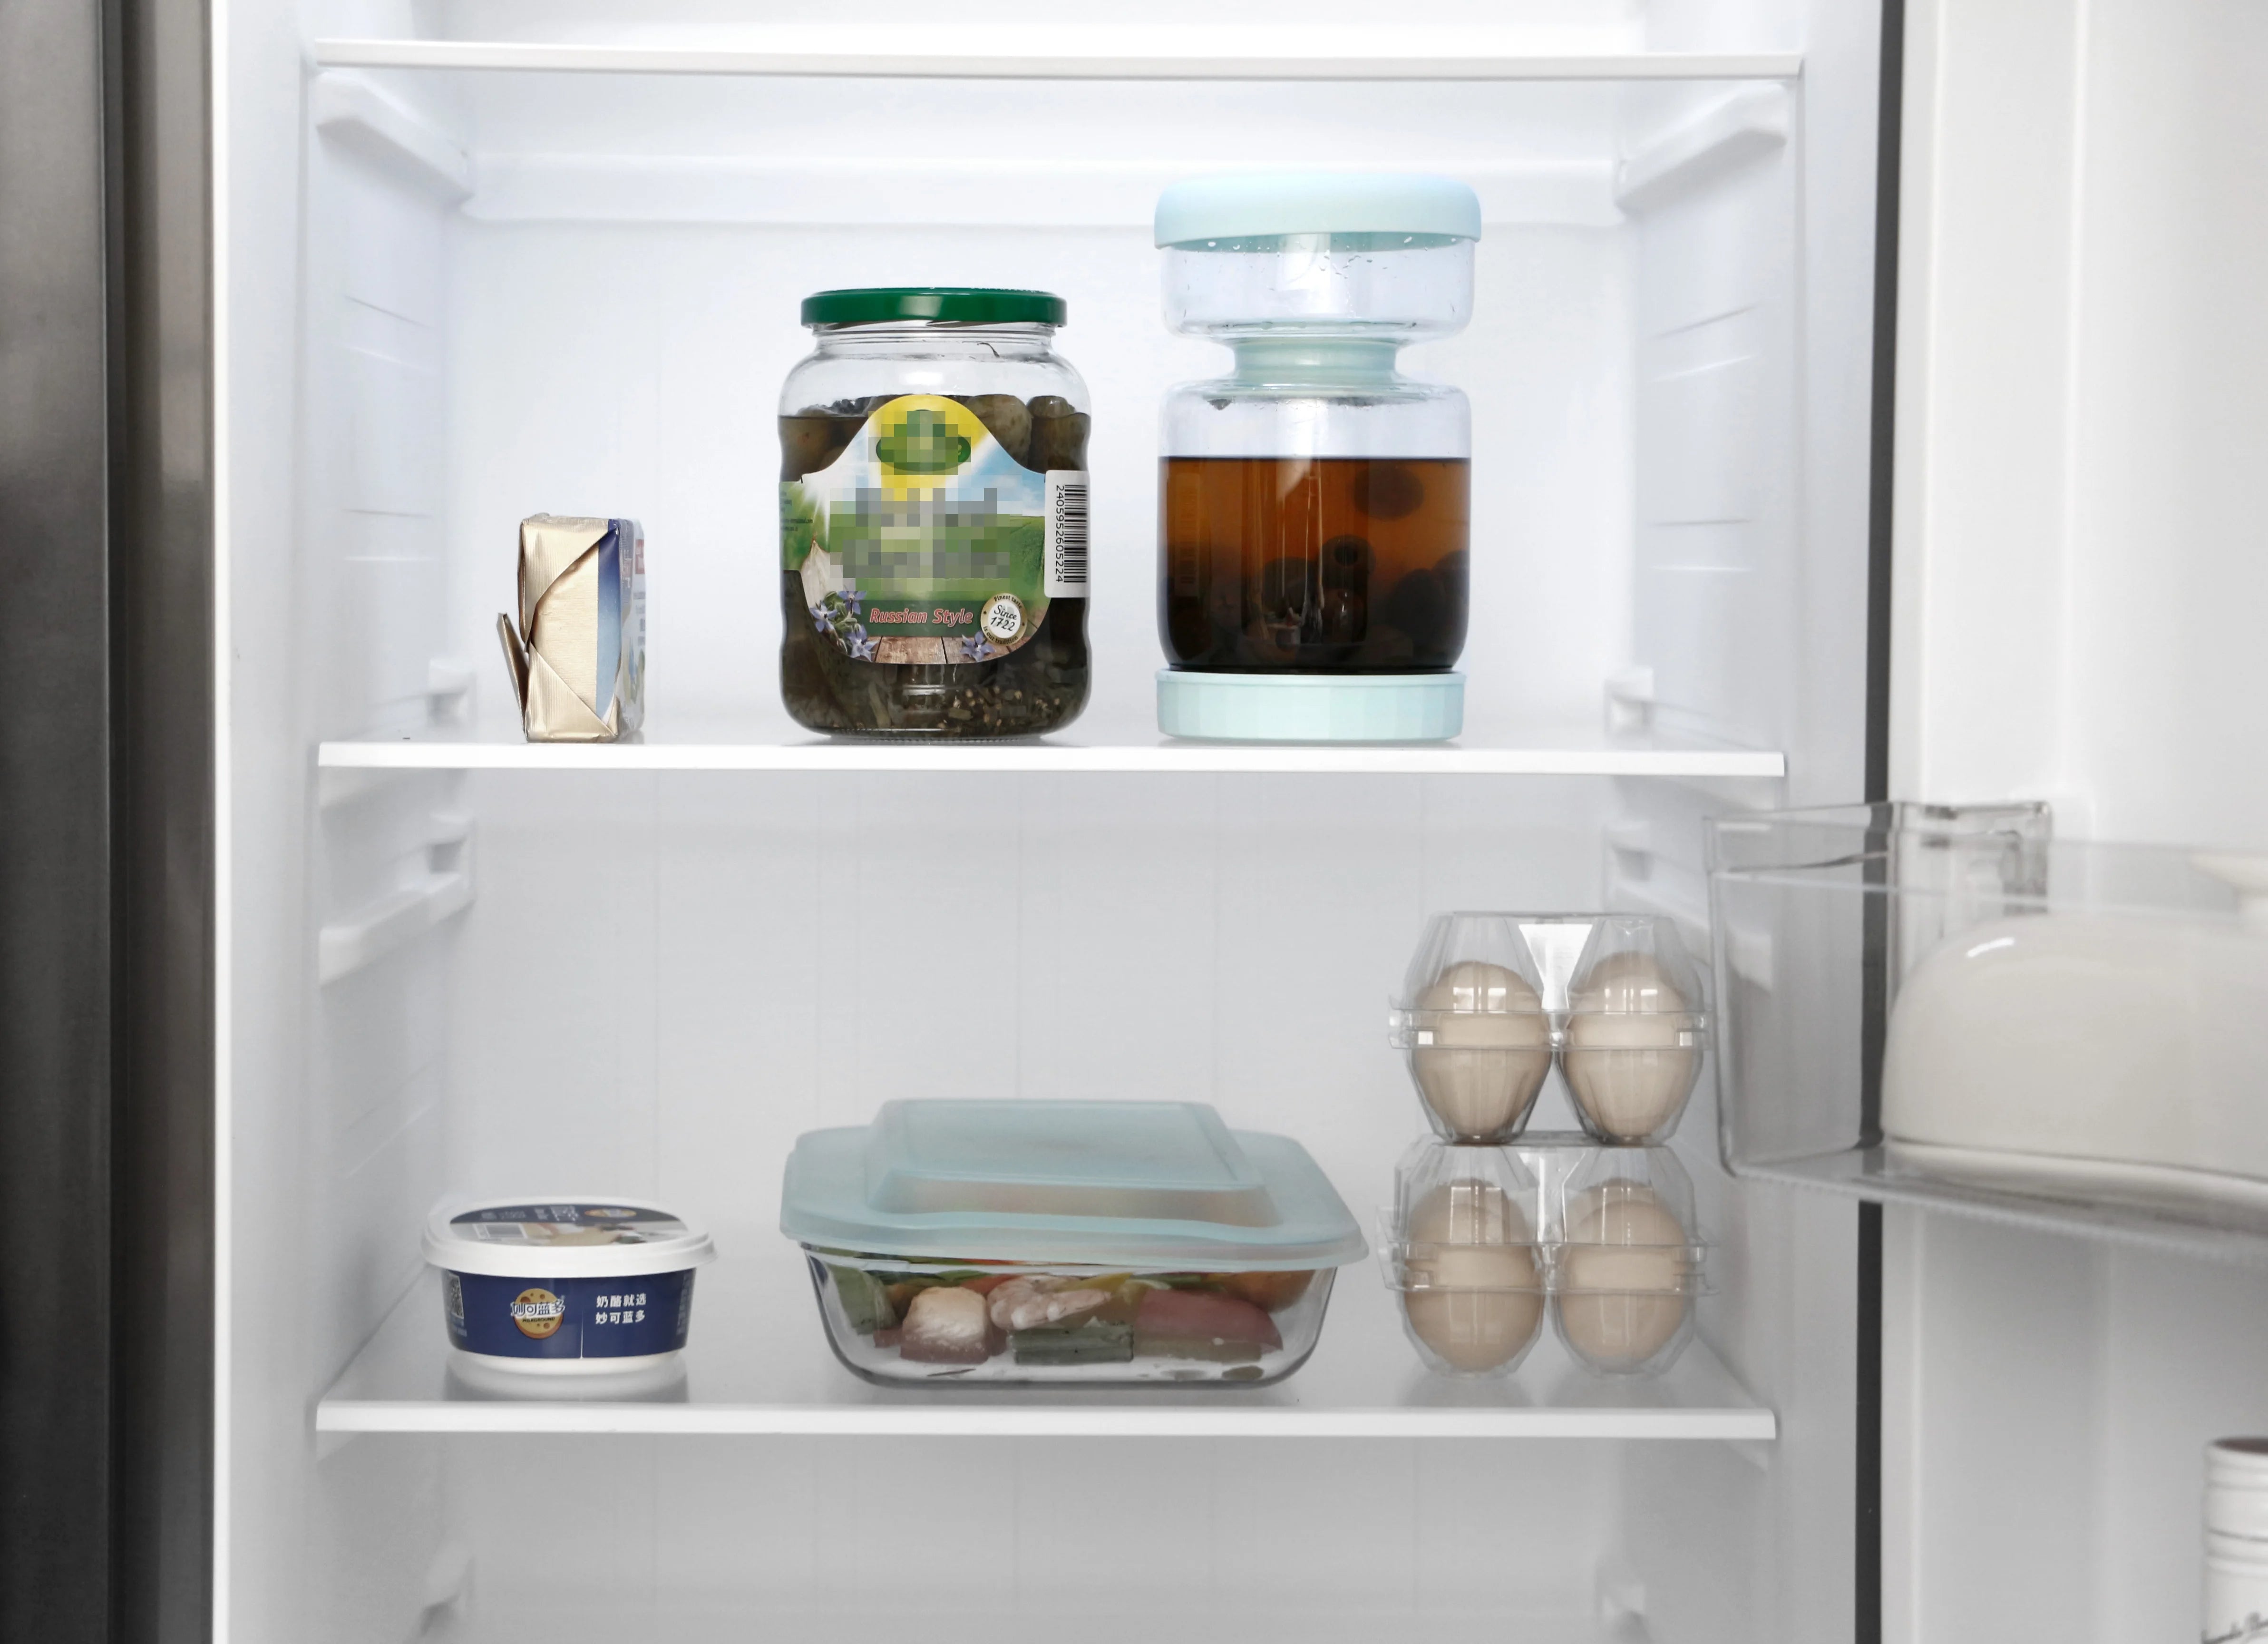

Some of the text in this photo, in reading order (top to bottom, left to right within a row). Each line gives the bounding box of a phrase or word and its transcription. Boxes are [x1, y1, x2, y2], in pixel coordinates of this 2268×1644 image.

[1056, 485, 1064, 583] 2405952605224
[1012, 597, 1022, 609] taste
[869, 608, 973, 627] Russian Style
[994, 605, 1017, 620] Since
[991, 617, 1015, 631] 1722
[986, 632, 995, 641] our
[596, 1293, 646, 1308] 奶酪就选
[595, 1310, 645, 1324] 妙可蓝多
